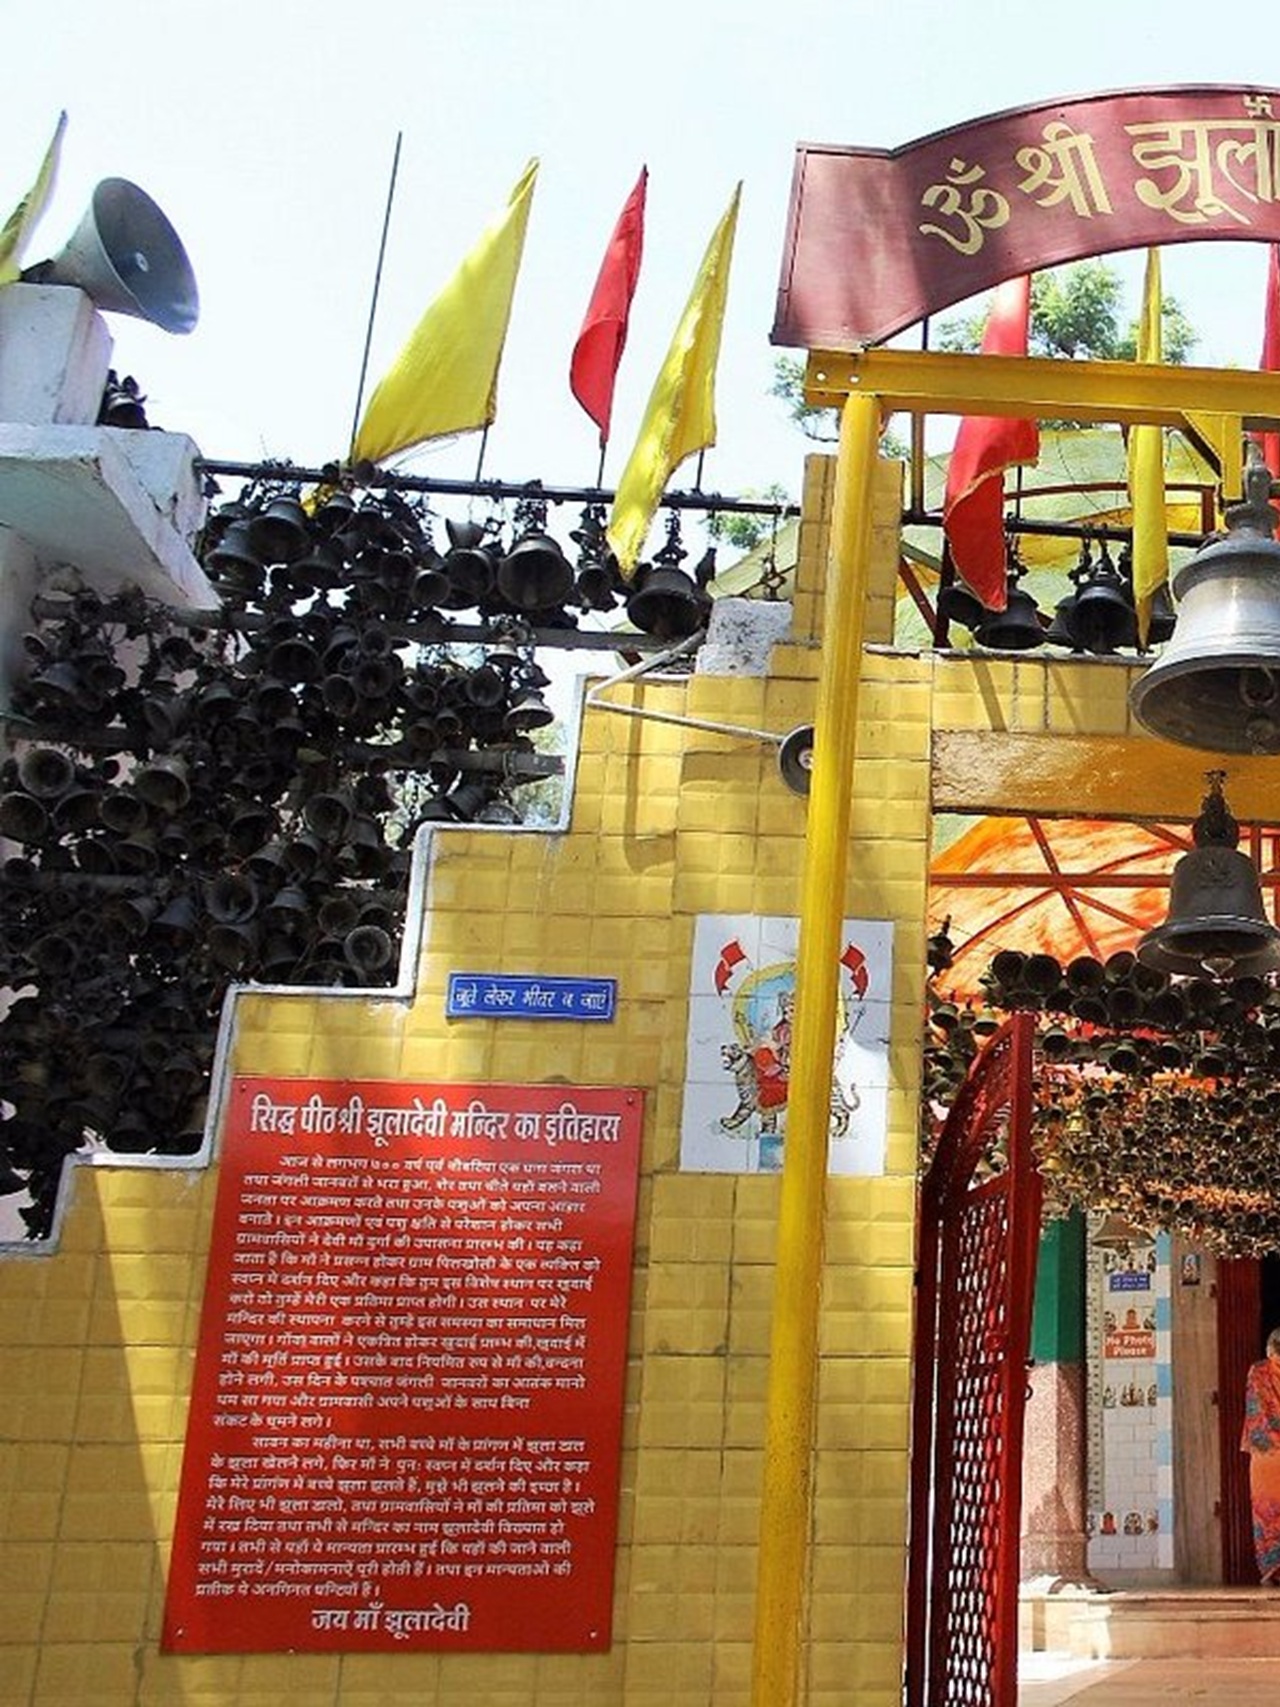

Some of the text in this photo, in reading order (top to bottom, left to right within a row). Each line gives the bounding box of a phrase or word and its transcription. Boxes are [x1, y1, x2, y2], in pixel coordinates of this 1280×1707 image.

[919, 158, 1010, 255] ॐ
[1016, 121, 1114, 219] श्री
[484, 983, 516, 1006] लेकर
[366, 1098, 448, 1147] झूलादेवी
[451, 1100, 509, 1141] मन्दिर
[514, 1112, 541, 1141] का
[544, 1103, 622, 1146] इतिहास
[312, 1601, 471, 1639] जय माँ झूलादेवी
